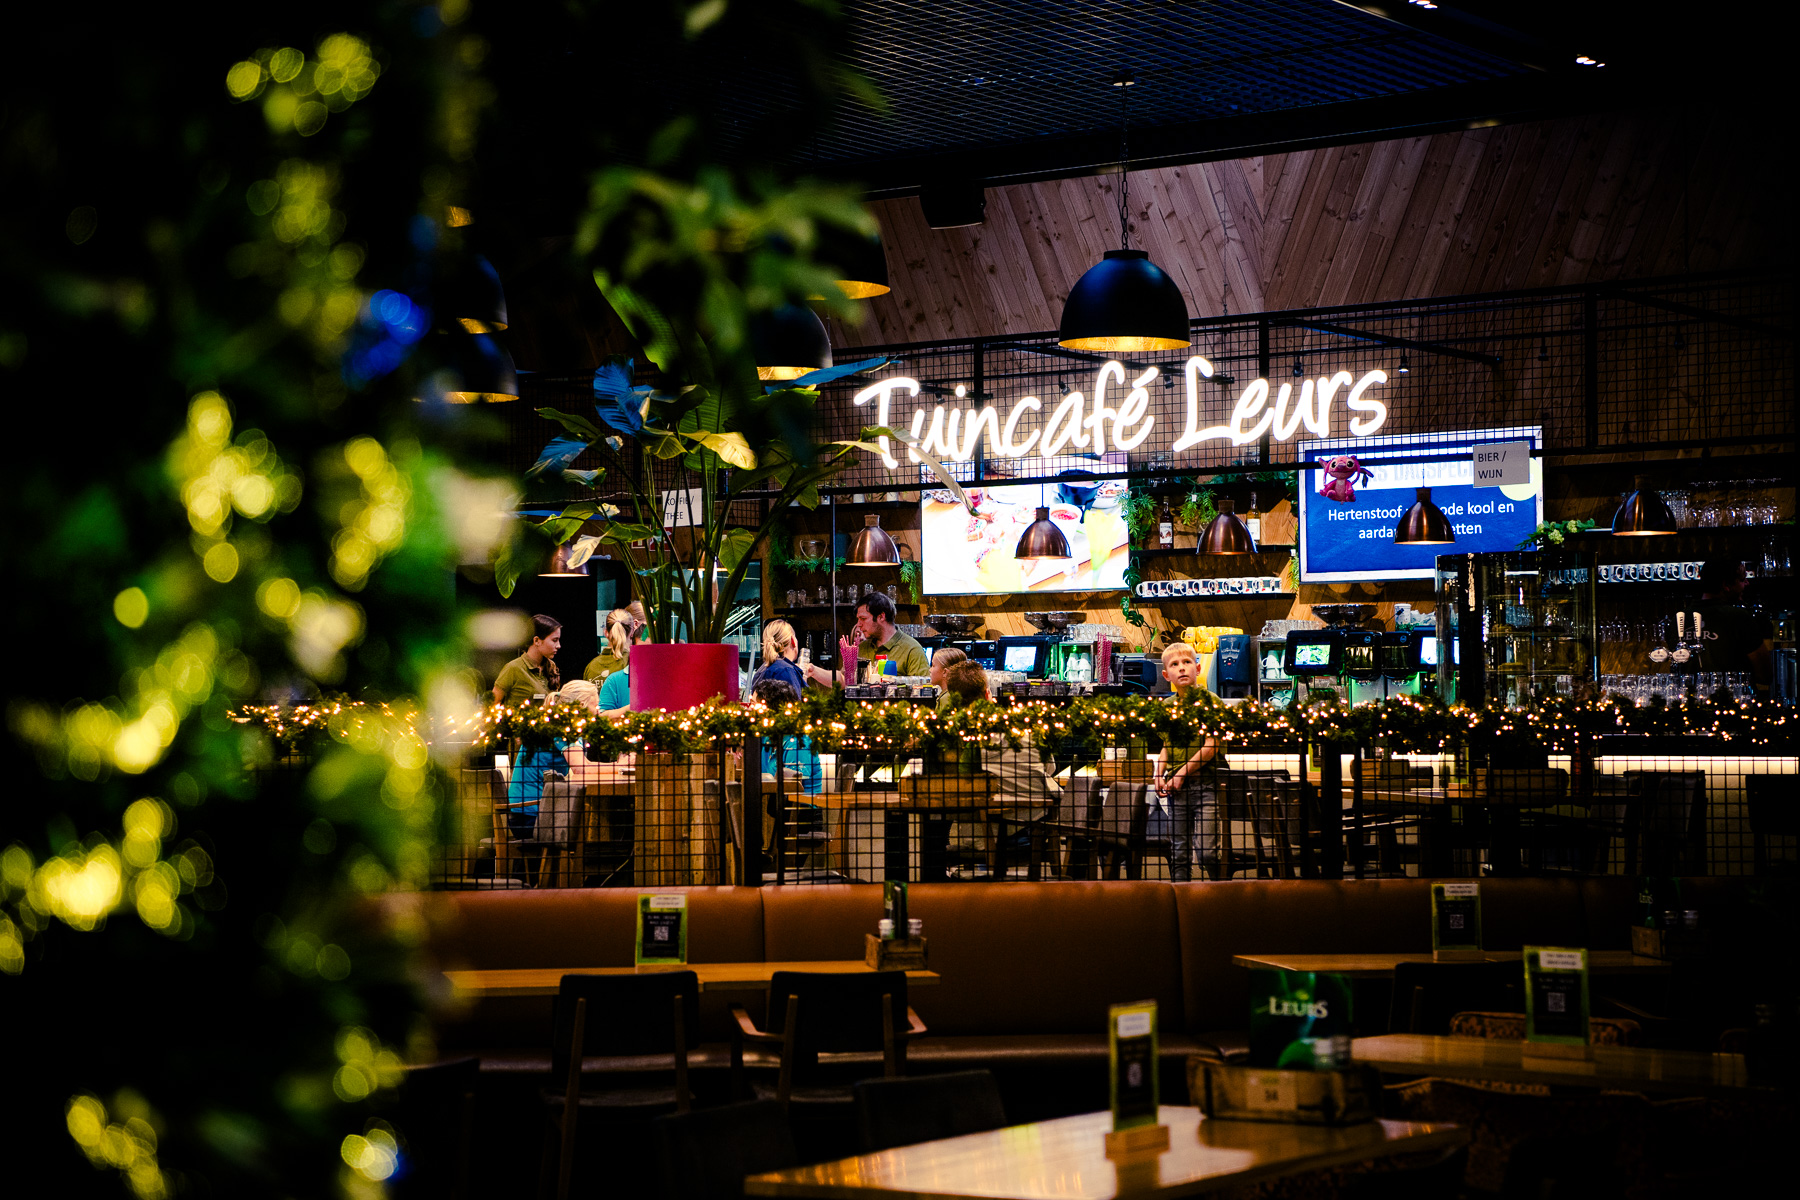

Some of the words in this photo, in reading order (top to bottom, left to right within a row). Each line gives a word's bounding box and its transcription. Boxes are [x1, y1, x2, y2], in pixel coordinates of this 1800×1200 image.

[854, 360, 1159, 469] Tuincafé
[1172, 355, 1389, 453] Leurs
[1478, 452, 1499, 462] BIER
[1478, 469, 1503, 479] WIJN
[1328, 505, 1402, 521] Hertenstoof
[1440, 502, 1464, 516] ode
[1467, 501, 1495, 515] kool
[1498, 503, 1515, 513] en
